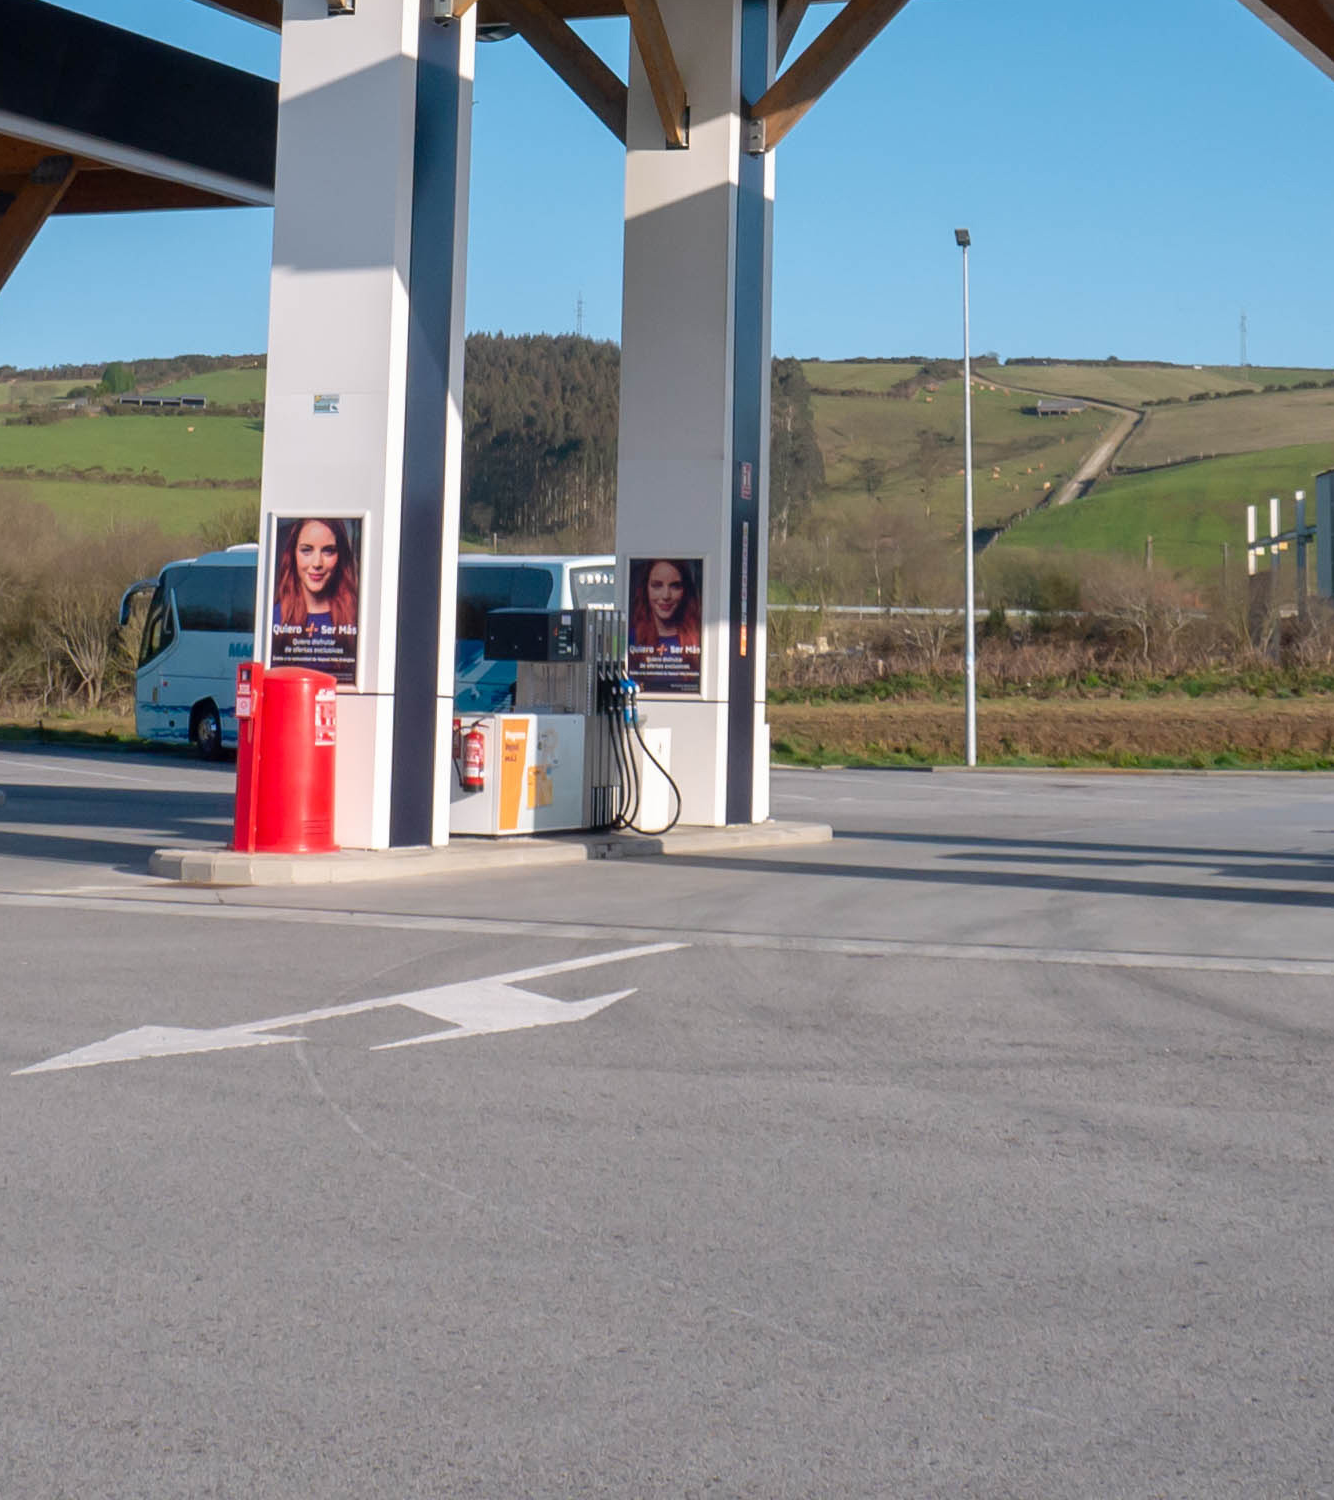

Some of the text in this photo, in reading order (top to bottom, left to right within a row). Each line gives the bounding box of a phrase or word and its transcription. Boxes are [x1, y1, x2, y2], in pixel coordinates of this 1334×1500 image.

[272, 623, 357, 635] Quiero Ser Más
